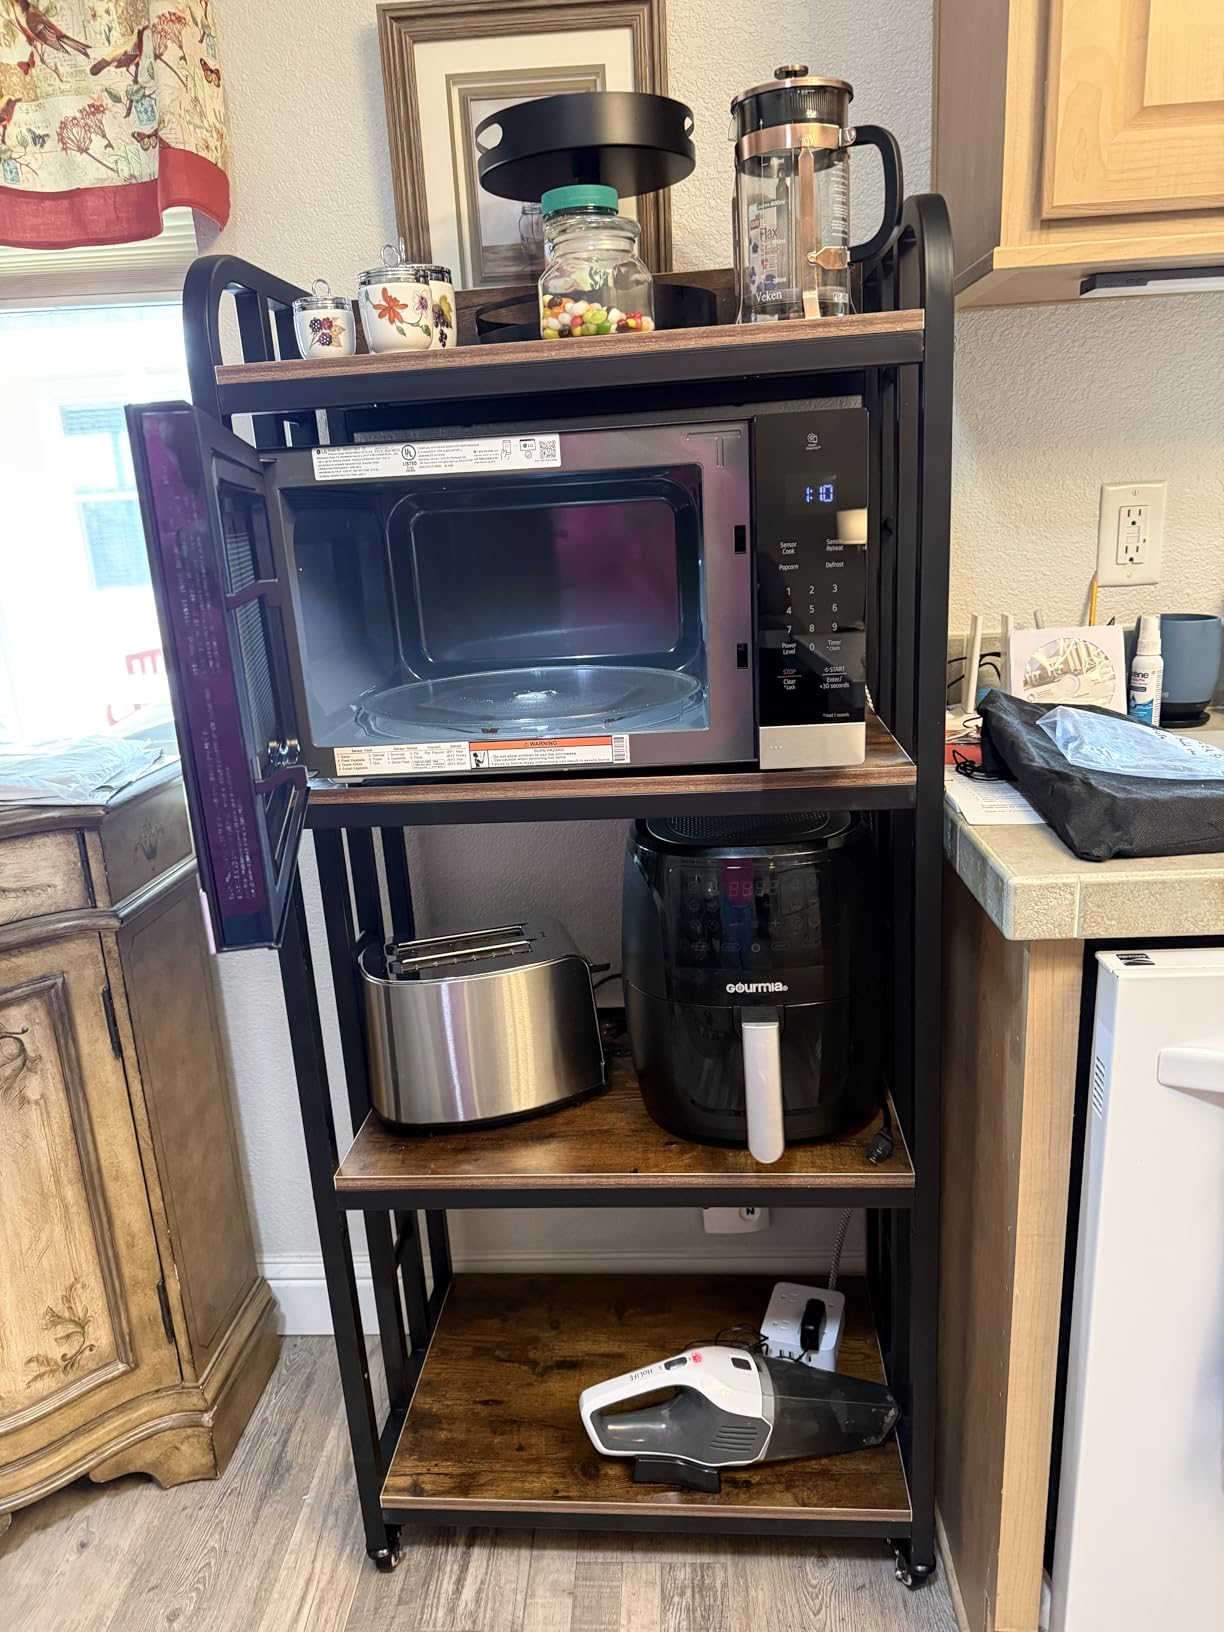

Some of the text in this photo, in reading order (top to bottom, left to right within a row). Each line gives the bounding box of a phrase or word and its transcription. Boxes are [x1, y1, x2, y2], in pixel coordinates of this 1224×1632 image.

[760, 227, 777, 240] Flax
[756, 290, 782, 303] Veken
[806, 484, 833, 502] 1:10
[809, 585, 815, 595] 2
[832, 584, 838, 593] 3
[786, 603, 838, 615] 4 5 6
[786, 622, 838, 634] 7 8 9
[809, 642, 815, 652] 0
